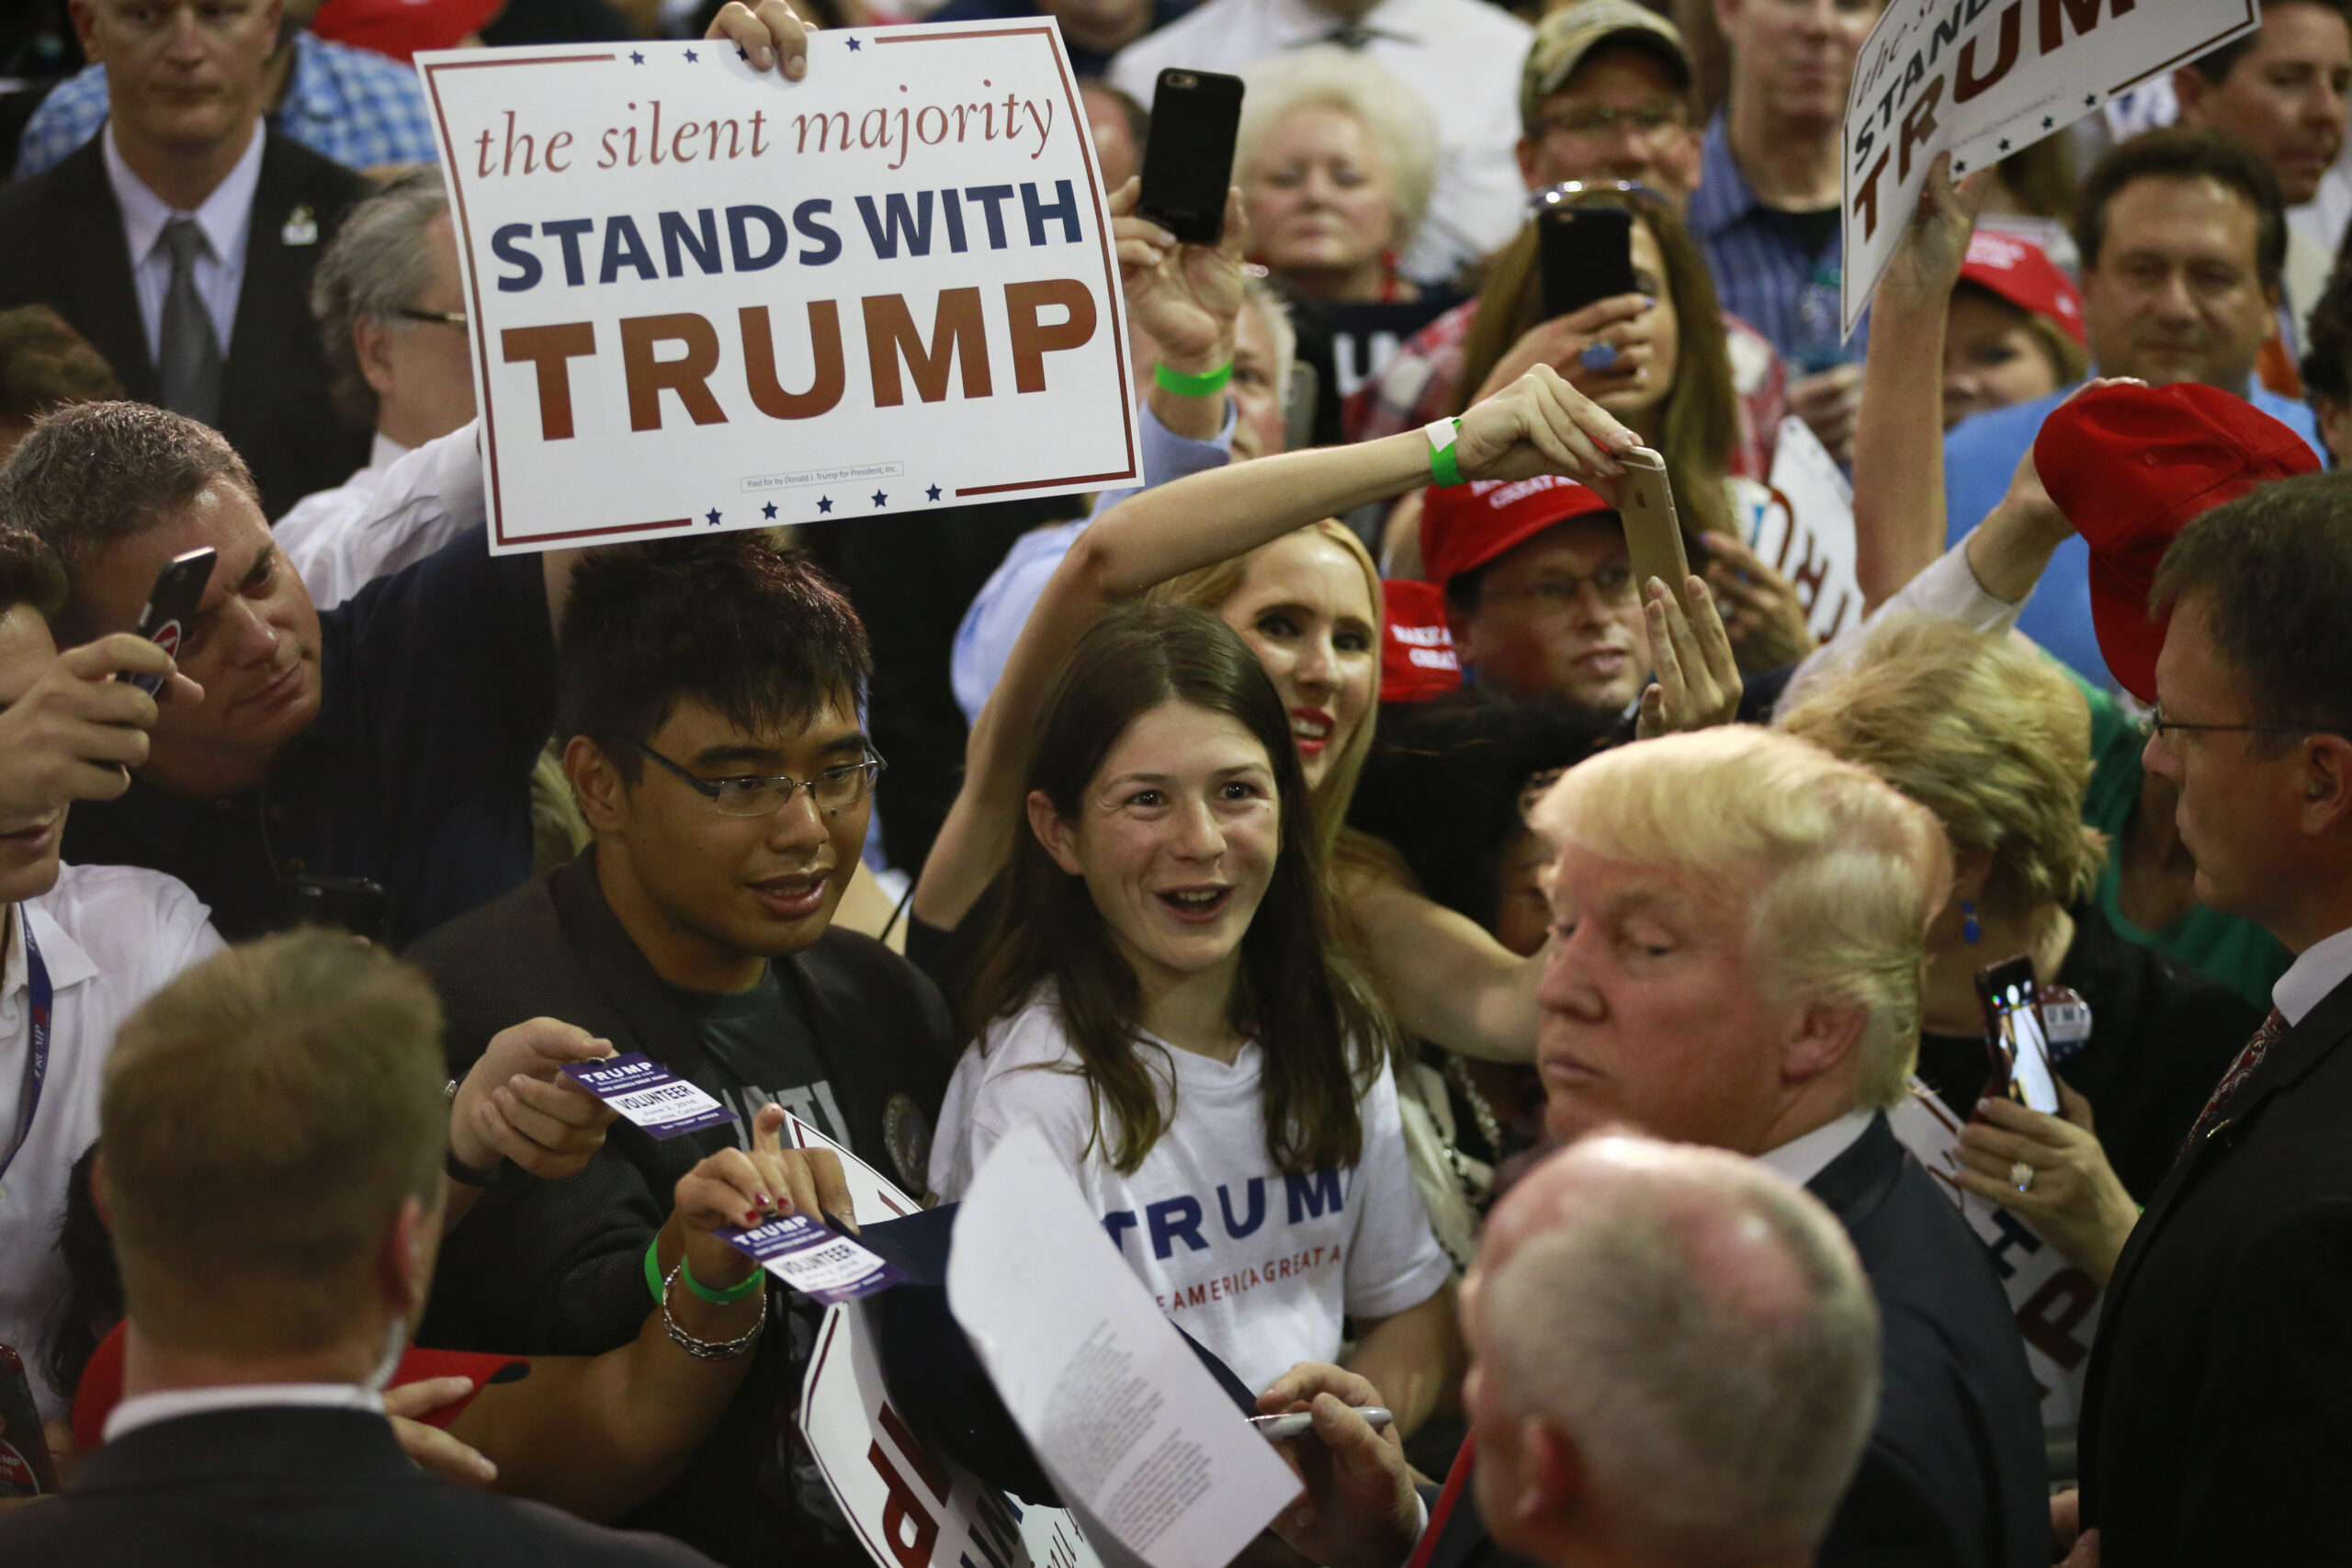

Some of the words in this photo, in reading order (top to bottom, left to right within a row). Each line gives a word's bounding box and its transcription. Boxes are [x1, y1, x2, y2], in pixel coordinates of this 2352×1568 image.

[1854, 0, 1991, 175] STAN
[475, 109, 573, 178] the
[597, 100, 770, 169] silent
[791, 79, 1054, 170] majority
[491, 198, 842, 293] STANDS
[854, 179, 1083, 260] WITH
[501, 278, 1097, 442] TRUMP
[747, 479, 763, 488] Paid
[763, 477, 774, 486] for
[775, 477, 783, 486] by
[785, 473, 809, 484] Donald
[816, 470, 839, 481] Trump
[840, 469, 850, 479] for
[851, 466, 884, 477] President,
[885, 465, 898, 474] Inc.
[578, 1062, 653, 1084] TRUMP
[615, 1085, 696, 1111] VOLUNTEER
[732, 1215, 808, 1246] TRUMP
[1101, 1168, 1353, 1260] TRUM
[780, 1244, 857, 1275] VOLUNTEER
[1172, 1269, 1261, 1312] AMERICA
[1262, 1246, 1326, 1283] GREAT
